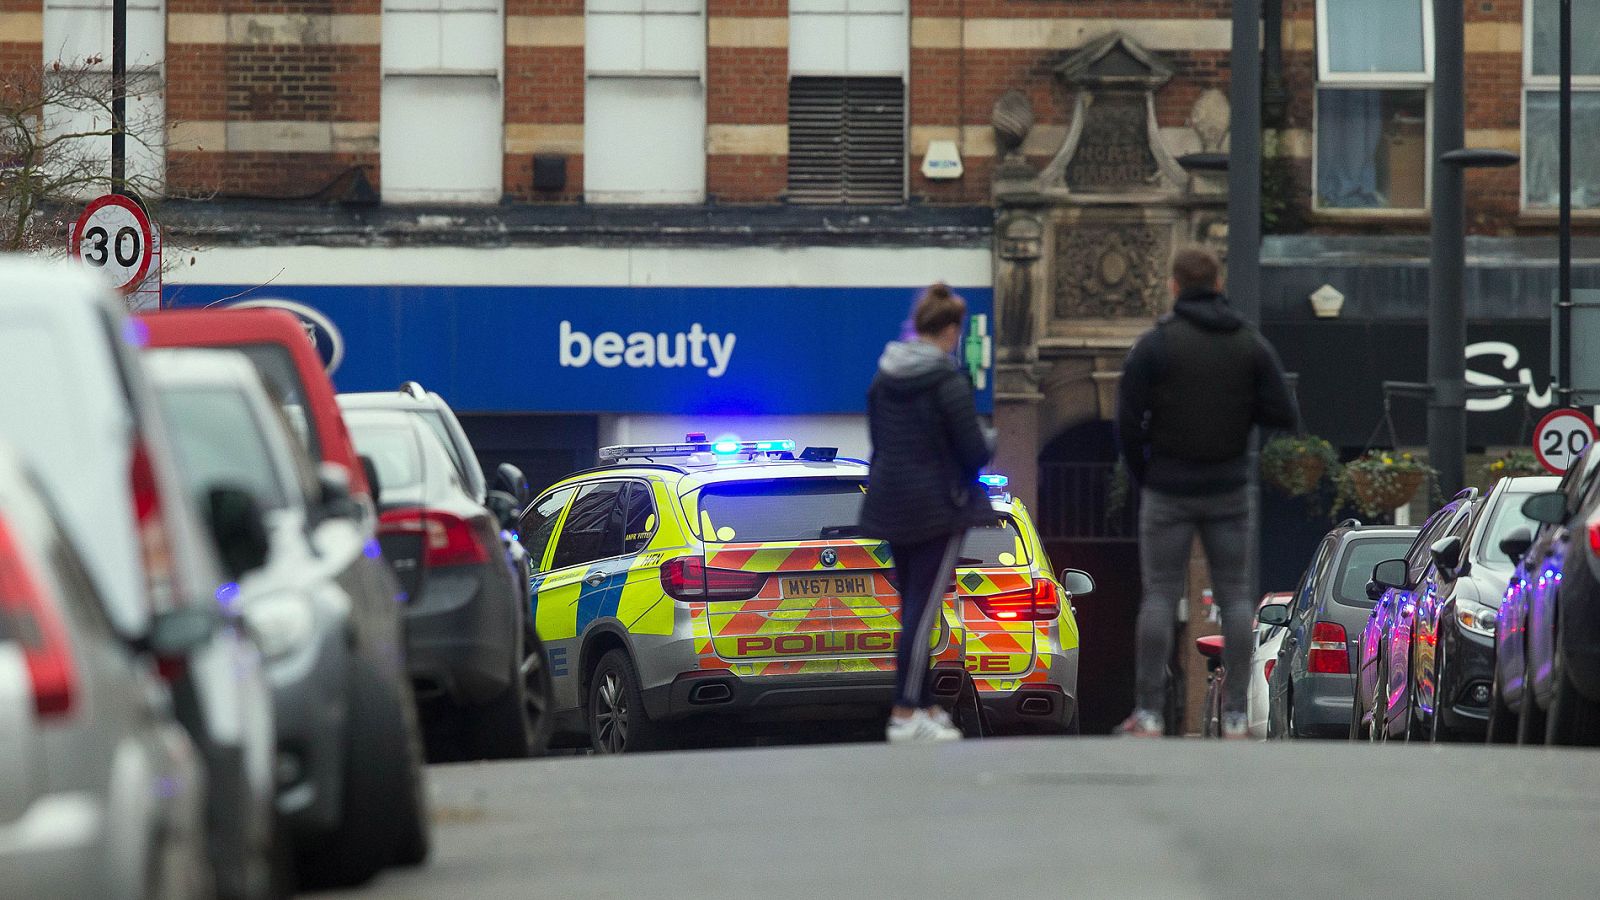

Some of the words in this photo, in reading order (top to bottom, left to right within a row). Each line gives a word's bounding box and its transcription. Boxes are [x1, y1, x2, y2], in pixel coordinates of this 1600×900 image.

[84, 226, 140, 268] 30
[559, 320, 737, 378] beauty
[1543, 429, 1589, 456] 20
[788, 579, 829, 595] MV67
[835, 578, 866, 593] BWH
[737, 632, 902, 656] POLIC
